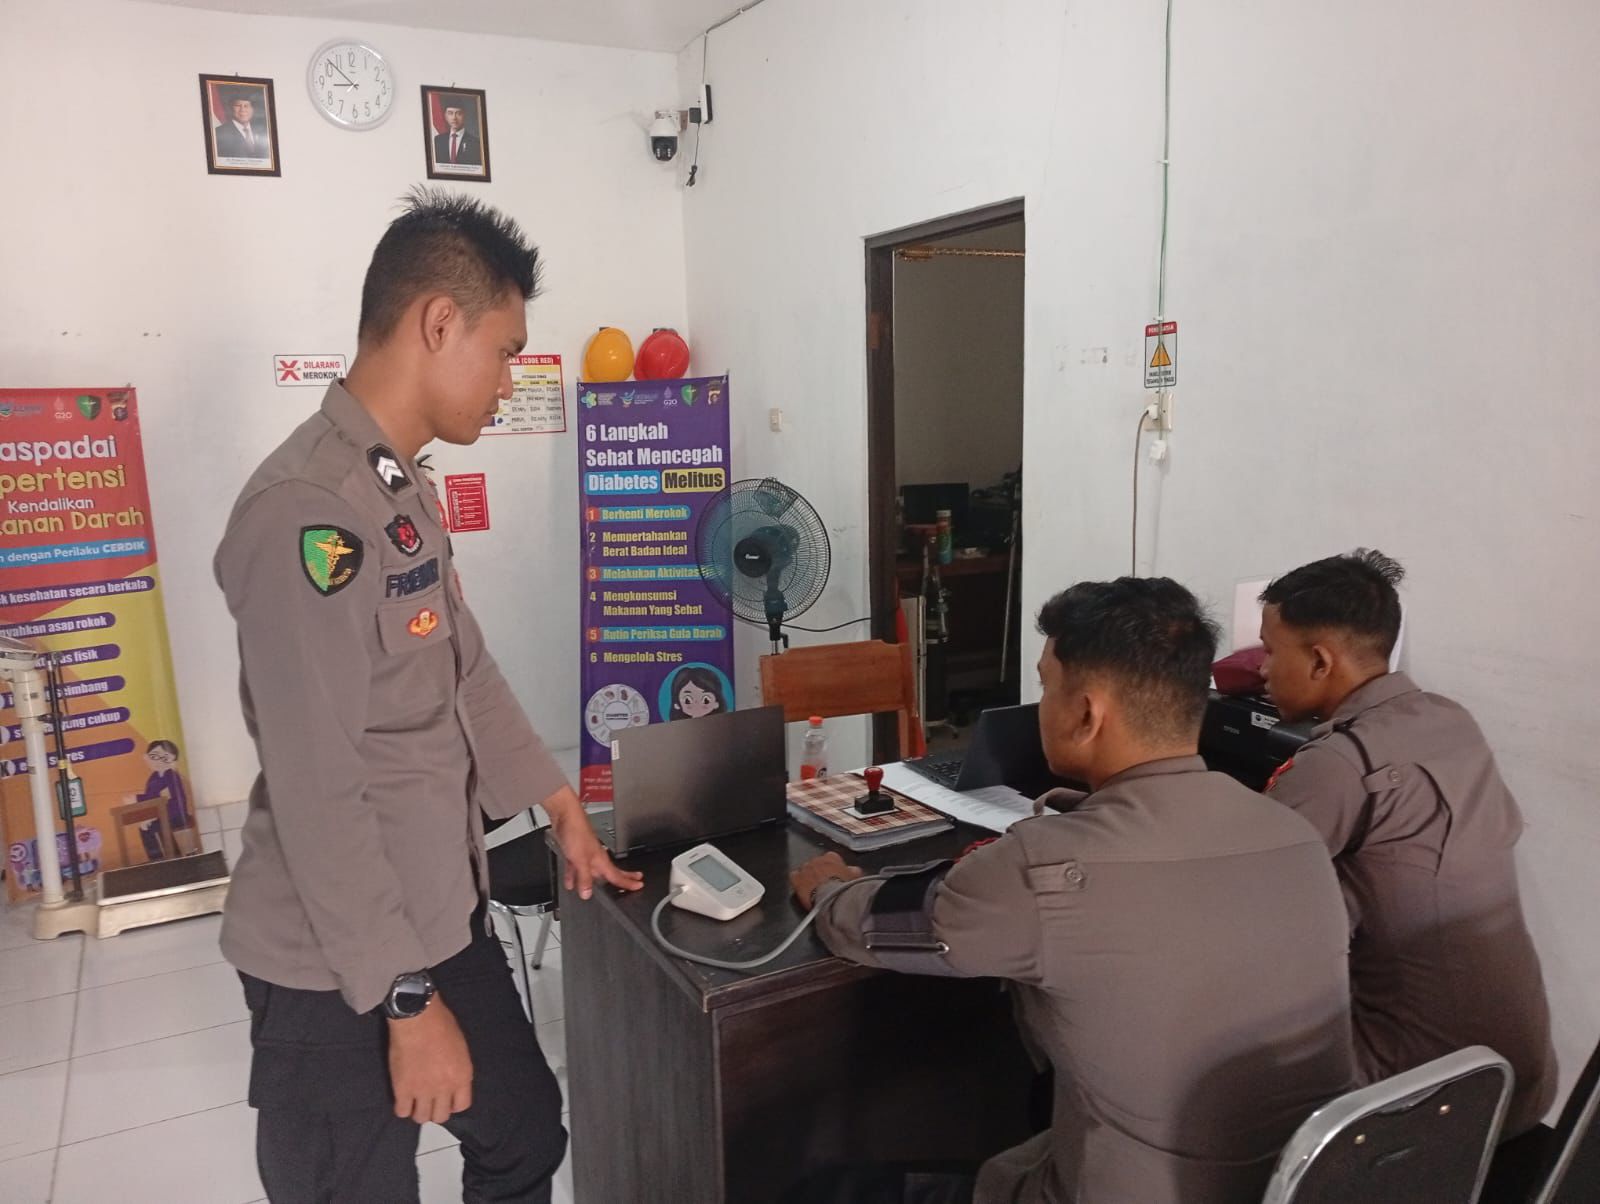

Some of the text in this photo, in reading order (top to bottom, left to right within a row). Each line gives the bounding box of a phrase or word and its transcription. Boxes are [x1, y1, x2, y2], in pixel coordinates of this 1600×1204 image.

[336, 54, 342, 70] 11
[347, 51, 356, 67] 12
[324, 62, 334, 77] 10
[374, 66, 380, 82] 2
[319, 75, 325, 89] 9
[381, 80, 387, 95] 3
[327, 90, 333, 105] 8
[375, 95, 381, 106] 4
[338, 99, 344, 114] 7
[352, 104, 358, 119] 6
[364, 101, 370, 117] 5
[303, 361, 341, 369] DILARANG
[303, 371, 338, 380] MEROKOK
[54, 411, 72, 419] G20
[585, 421, 669, 443] 6 Langkah
[0, 435, 118, 466] aspadai
[586, 445, 723, 467] Sehat Mencegah
[0, 465, 127, 500] pertensi
[588, 471, 724, 491] Diabetes Melitus
[8, 498, 95, 514] Kendalikan
[589, 507, 688, 520] 1 Berhenti Merokok
[0, 507, 145, 536] anan Darah
[589, 531, 688, 544] 2 Mempertahankan
[7, 549, 52, 564] dengan
[54, 546, 100, 559] Perilaku
[102, 540, 146, 554] CERDIK
[602, 544, 688, 557] Berat Badan Ideal
[590, 570, 597, 580] 3
[603, 568, 656, 579] Melakukan
[657, 567, 700, 578] Aktivitas
[10, 587, 68, 604] kesehatan
[69, 582, 106, 597] secara
[107, 579, 148, 593] berkala
[589, 589, 677, 603] 4 Mengkonsumsi
[603, 604, 703, 617] Makanan Yang Sehat
[0, 615, 107, 638] nyahkan asap rokok
[590, 627, 722, 640] 5 Rutin Periksa Gula Darah
[73, 650, 99, 663] fisik
[590, 651, 683, 664] 6 Mengelola Stres
[87, 710, 121, 727] cukup
[49, 750, 85, 767] sres
